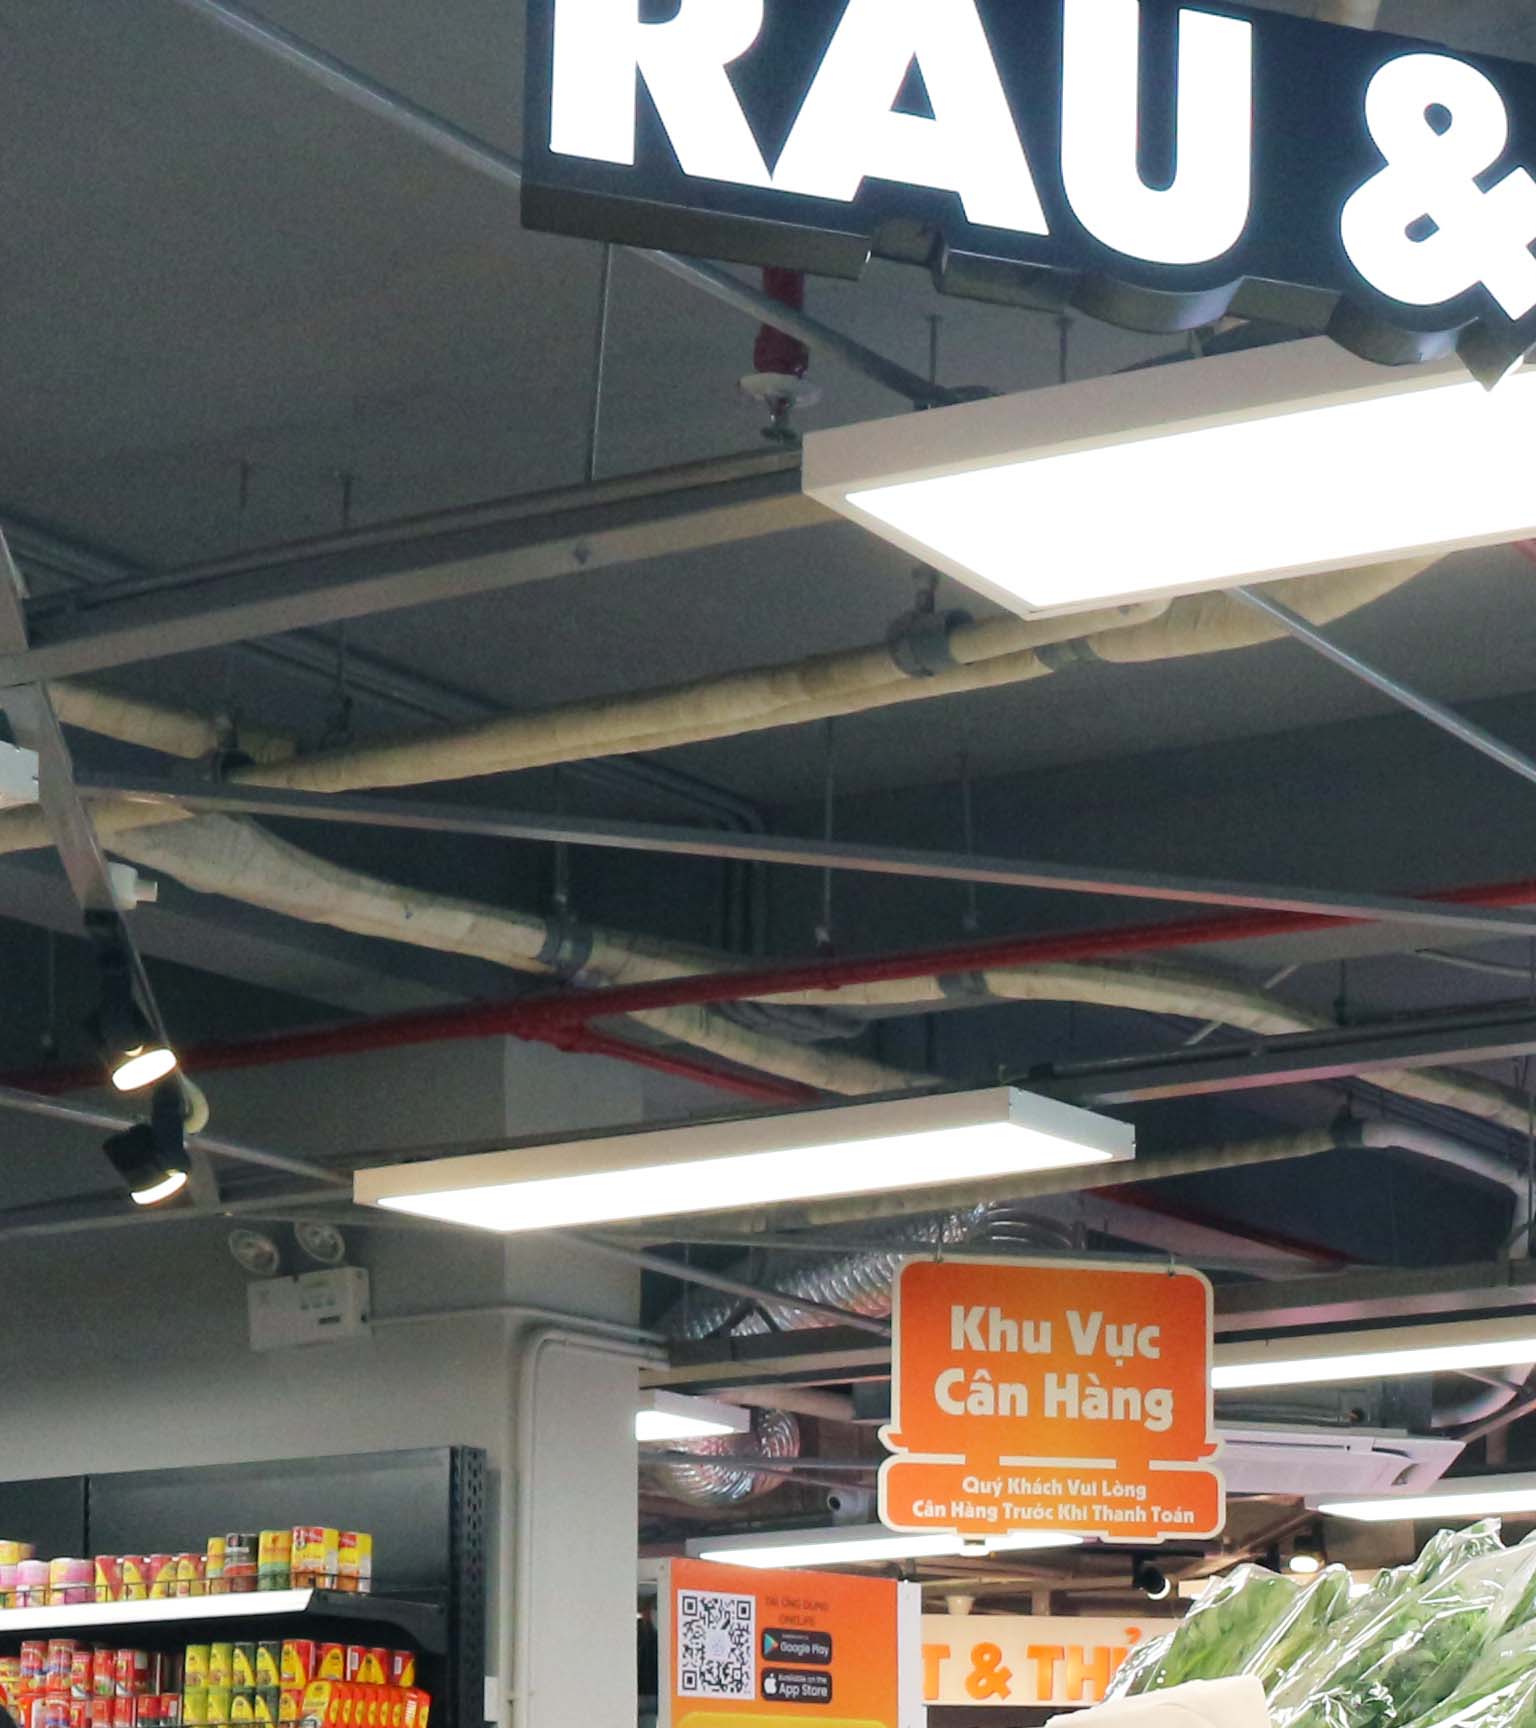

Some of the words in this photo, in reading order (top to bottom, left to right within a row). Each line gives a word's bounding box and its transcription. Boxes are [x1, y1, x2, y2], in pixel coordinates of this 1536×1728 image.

[549, 0, 1253, 268] RAU
[951, 1305, 1052, 1353] Khu
[1066, 1310, 1161, 1367] Vực
[934, 1368, 1028, 1418] Cân
[1044, 1372, 1174, 1432] Hàng
[962, 1475, 1003, 1499] Quý
[1008, 1477, 1062, 1496] Khách
[1068, 1479, 1097, 1497] Vui
[1102, 1480, 1147, 1500] Lòng
[912, 1500, 946, 1518] Cân
[951, 1501, 998, 1522] Hàng
[1002, 1502, 1054, 1520] Trước
[1058, 1503, 1087, 1521] Khi
[1092, 1505, 1146, 1522] Thanh
[1151, 1505, 1195, 1523] Toán
[780, 1641, 811, 1656] Google
[812, 1644, 829, 1657] Play
[779, 1683, 799, 1698] App
[801, 1684, 828, 1697] Store
[965, 1642, 1013, 1700] &
